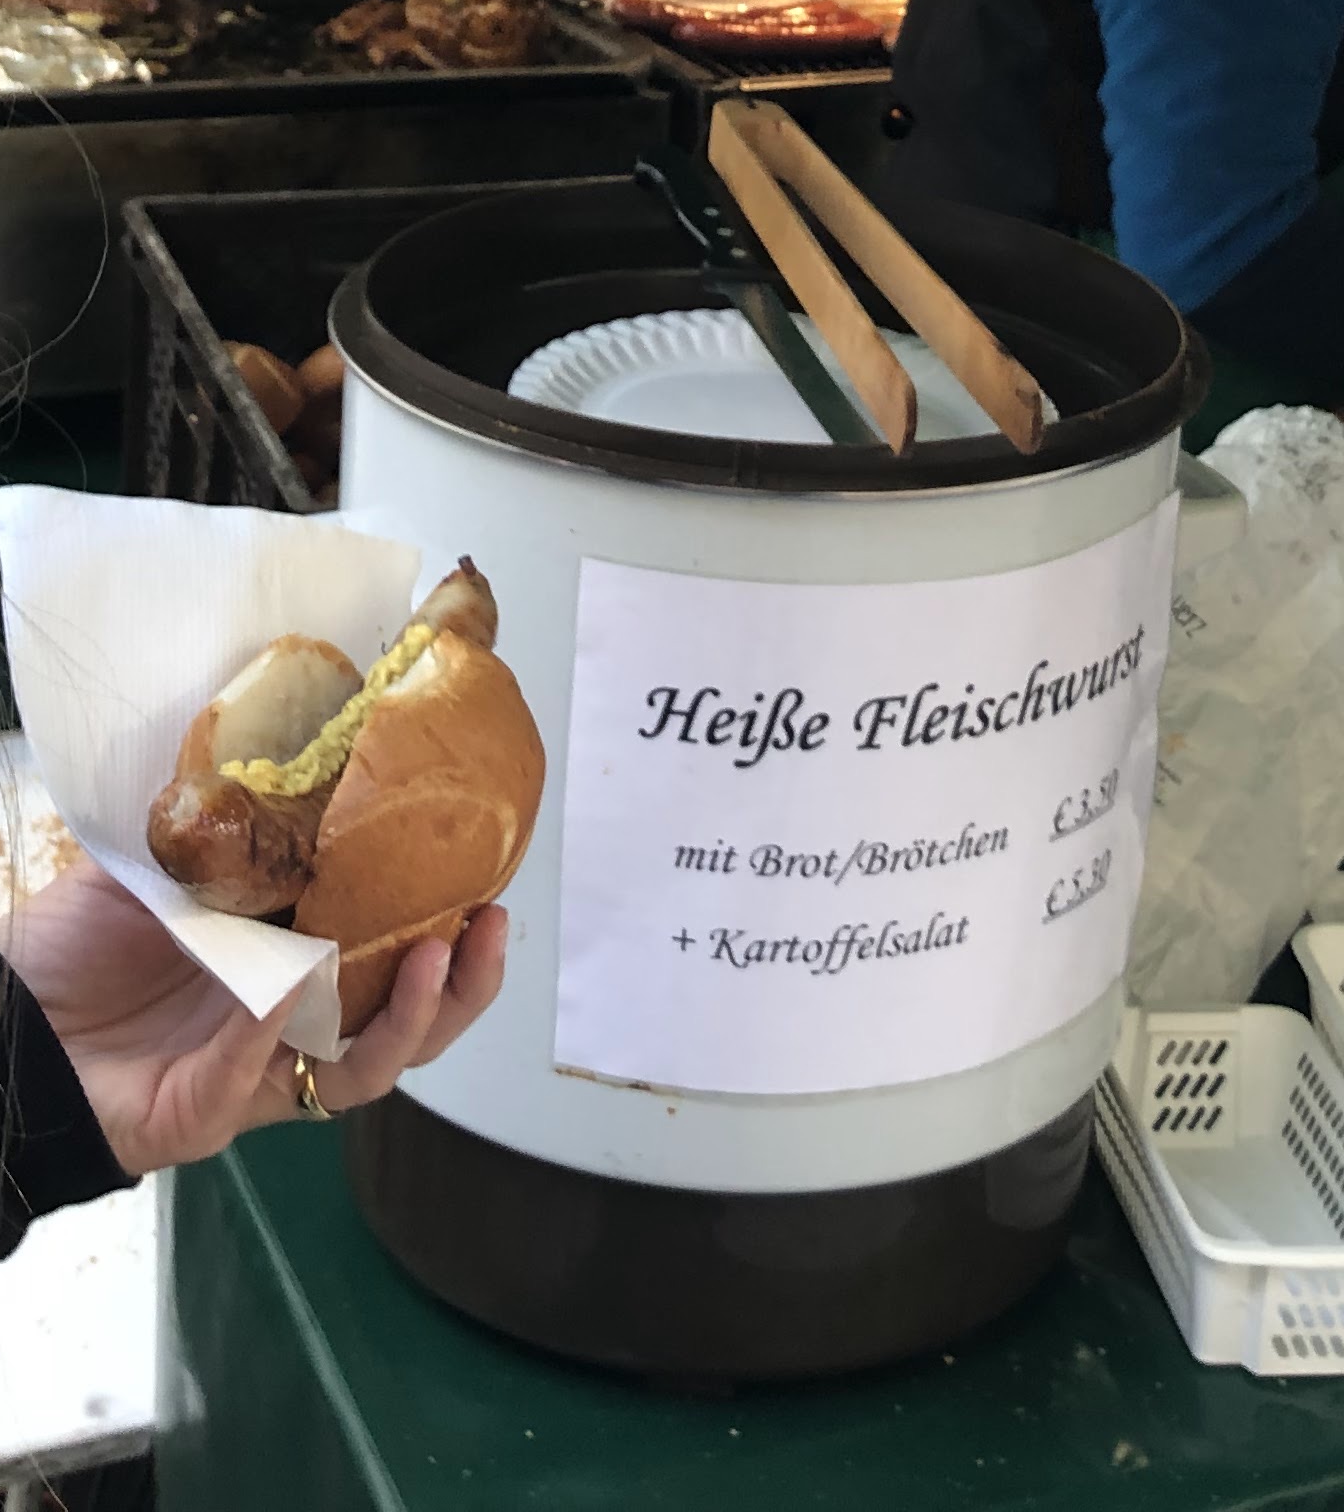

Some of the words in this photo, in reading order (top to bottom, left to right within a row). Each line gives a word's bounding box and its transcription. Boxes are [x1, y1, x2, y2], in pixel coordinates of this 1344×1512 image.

[638, 685, 829, 768] Heiße
[853, 624, 1145, 752] Fleischwurst
[673, 838, 738, 876] mit
[749, 822, 1010, 886] Brot/Brötchen
[710, 912, 971, 976] Kartoffelsalat
